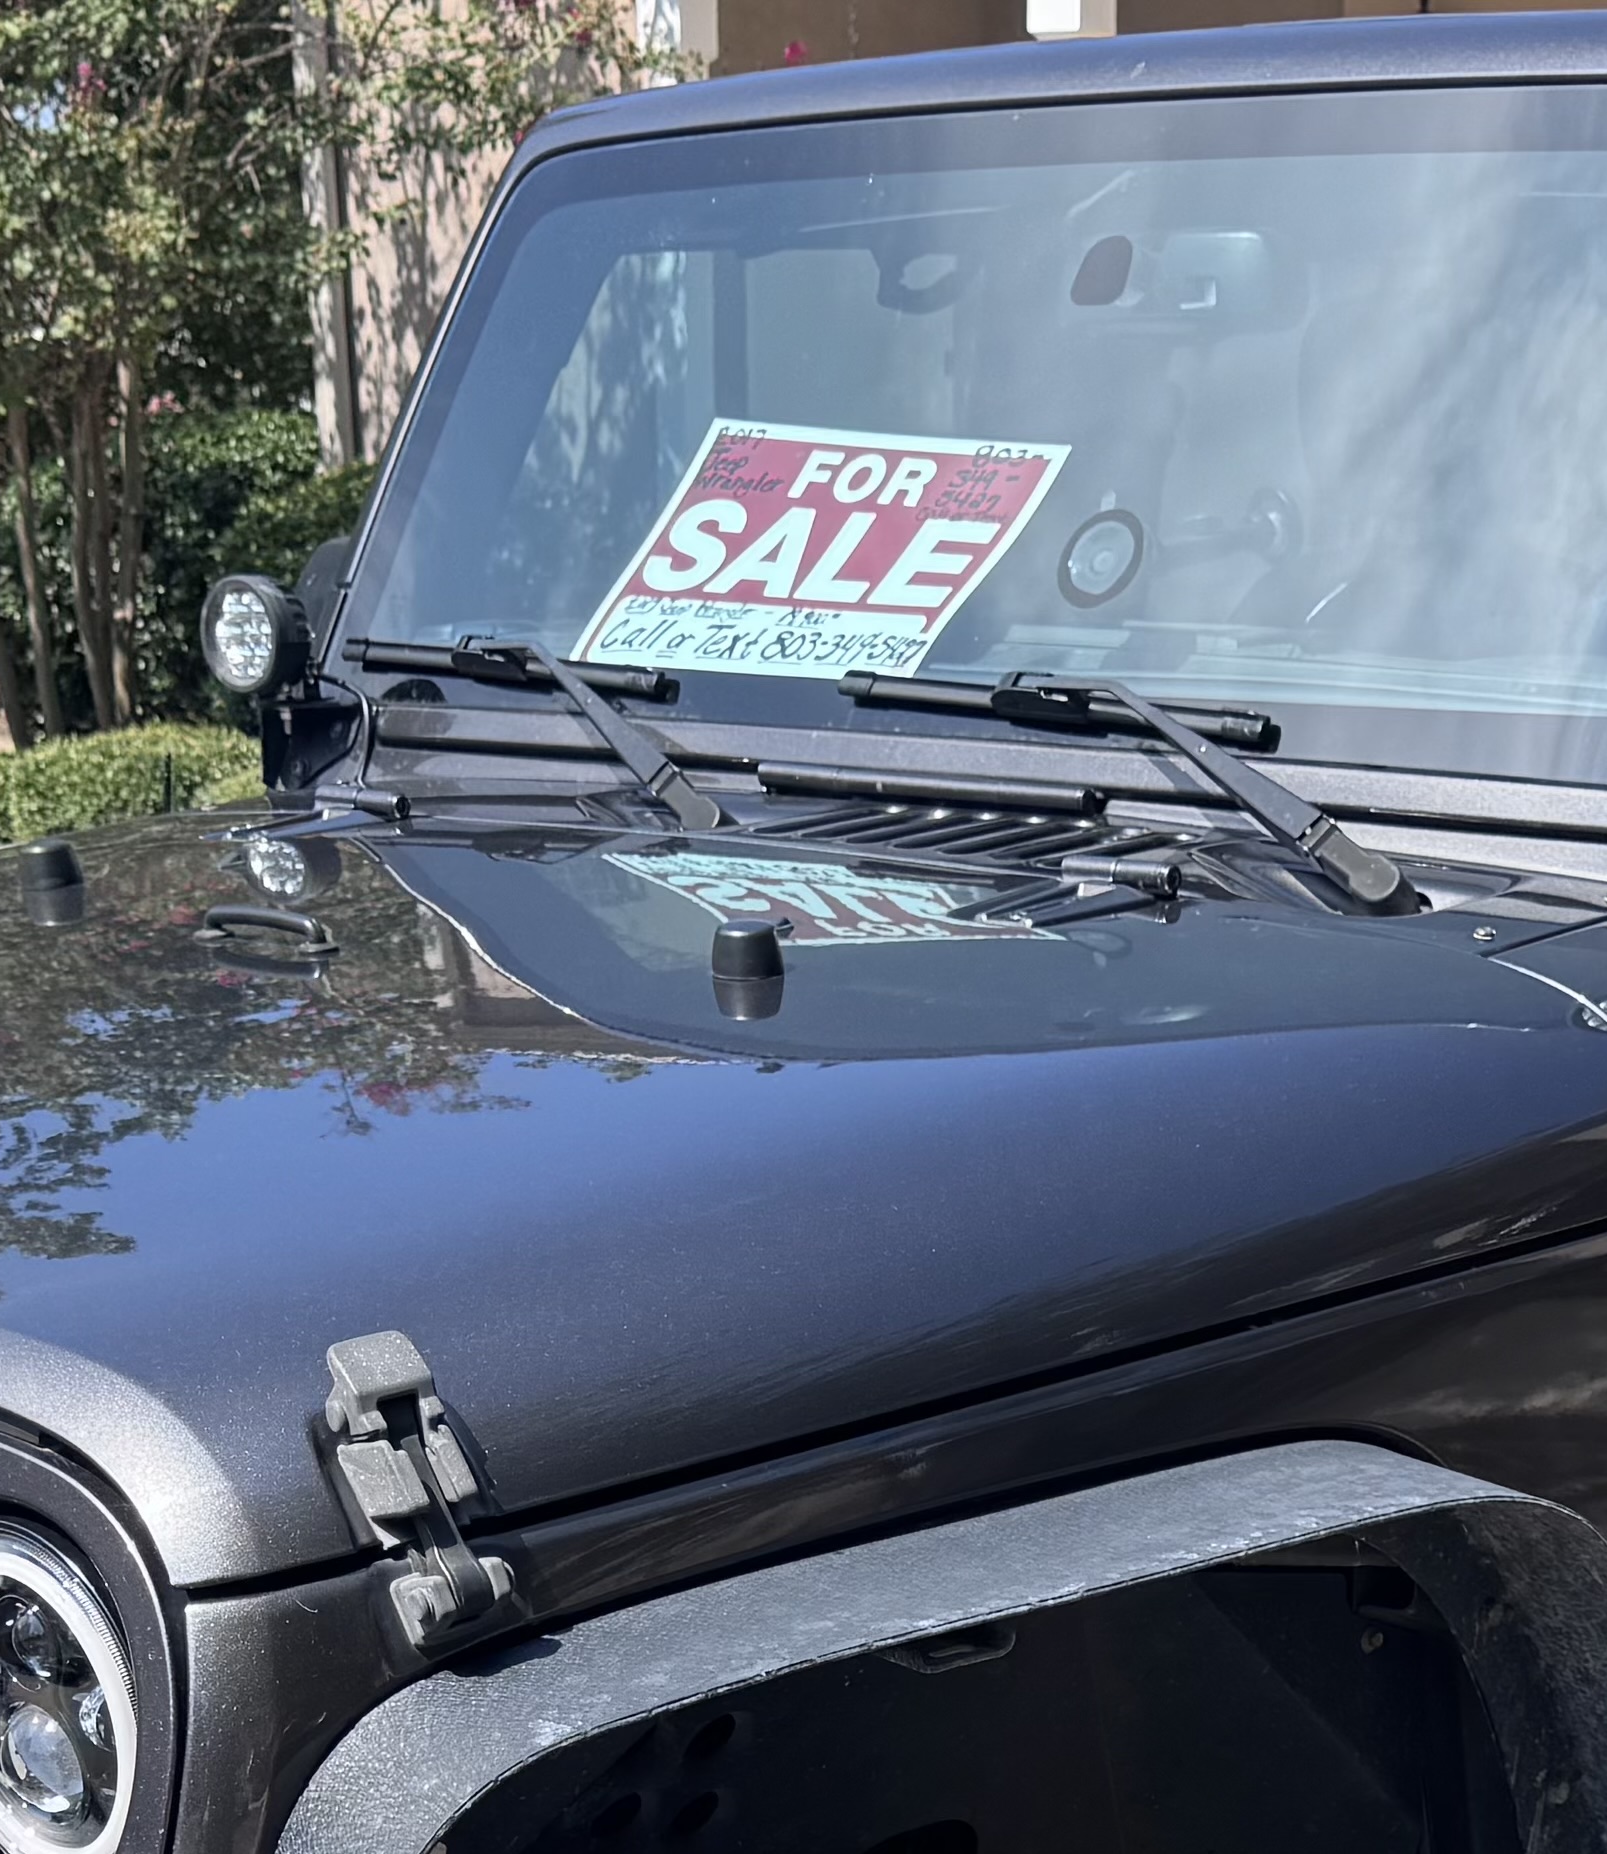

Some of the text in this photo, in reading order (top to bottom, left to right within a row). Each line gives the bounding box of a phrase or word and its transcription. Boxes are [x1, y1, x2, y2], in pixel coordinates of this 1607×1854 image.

[789, 450, 937, 507] FOR
[643, 500, 1001, 608] SALE
[600, 618, 666, 652] Call
[667, 631, 695, 650] or
[692, 622, 770, 659] Text
